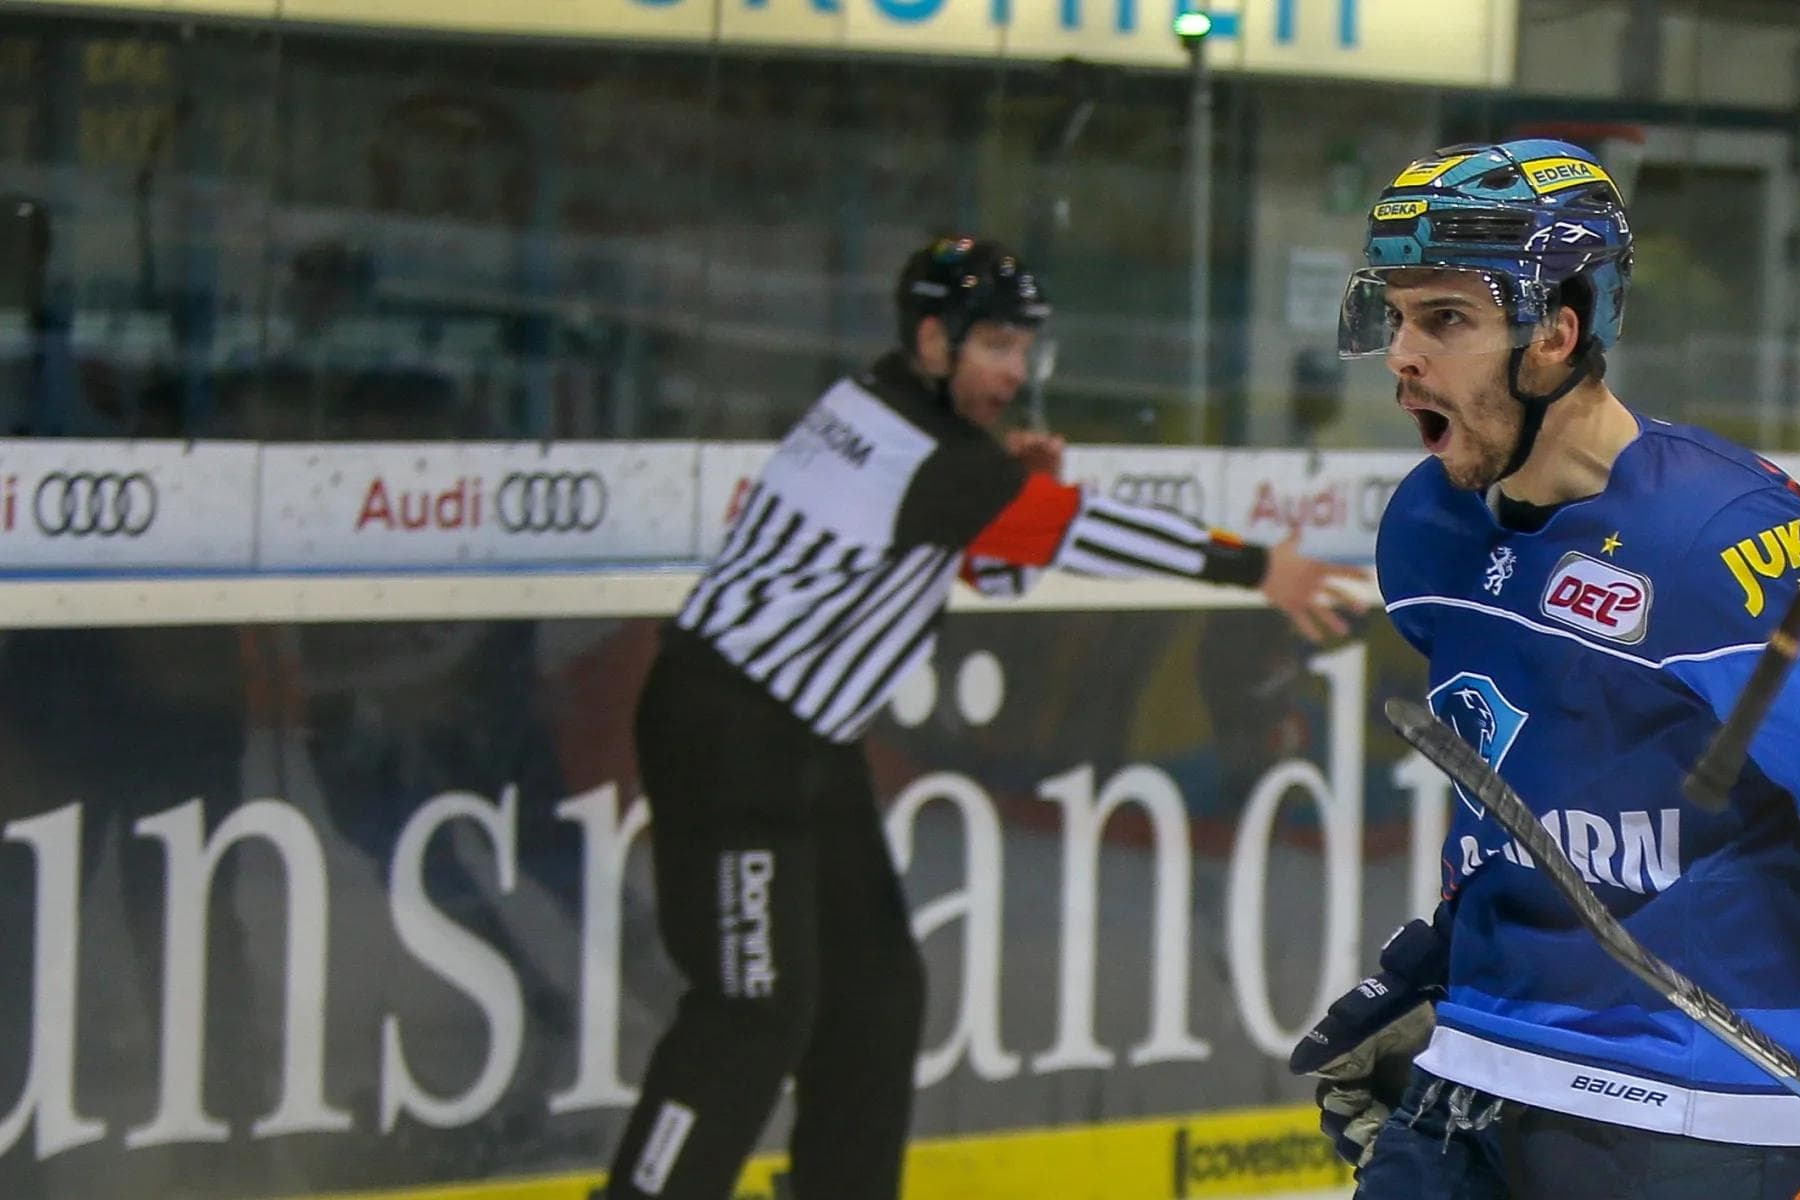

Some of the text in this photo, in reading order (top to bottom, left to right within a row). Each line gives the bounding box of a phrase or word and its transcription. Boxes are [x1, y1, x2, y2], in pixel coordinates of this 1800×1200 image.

[1533, 163, 1593, 184] EDEKA
[1376, 201, 1418, 217] EDEKA
[357, 477, 483, 531] Audi
[1250, 480, 1347, 529] Audi
[1571, 1074, 1669, 1109] BAUER
